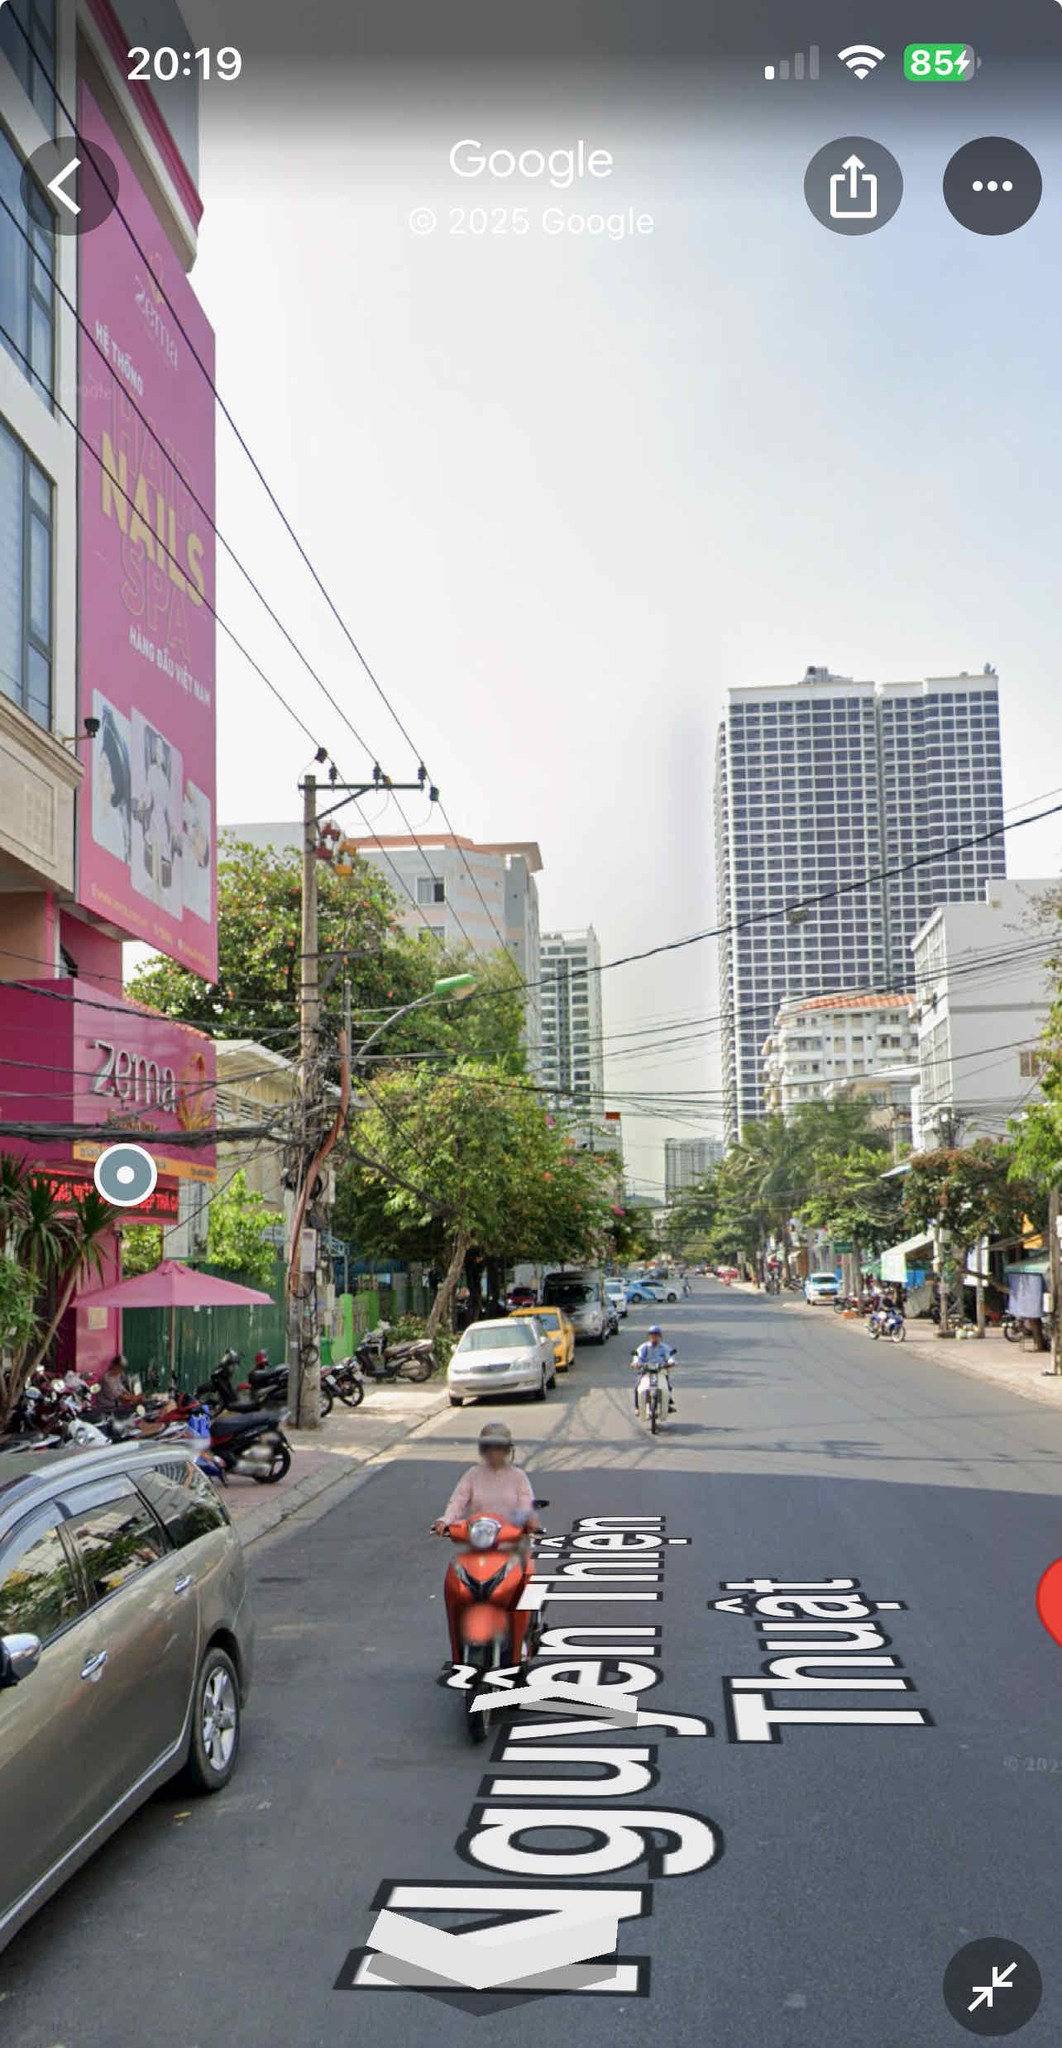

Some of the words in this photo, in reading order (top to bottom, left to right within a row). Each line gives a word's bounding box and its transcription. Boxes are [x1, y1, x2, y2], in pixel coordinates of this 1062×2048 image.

[102, 431, 205, 607] NAILS
[128, 622, 155, 663] HÀNG
[93, 1039, 177, 1114] zema
